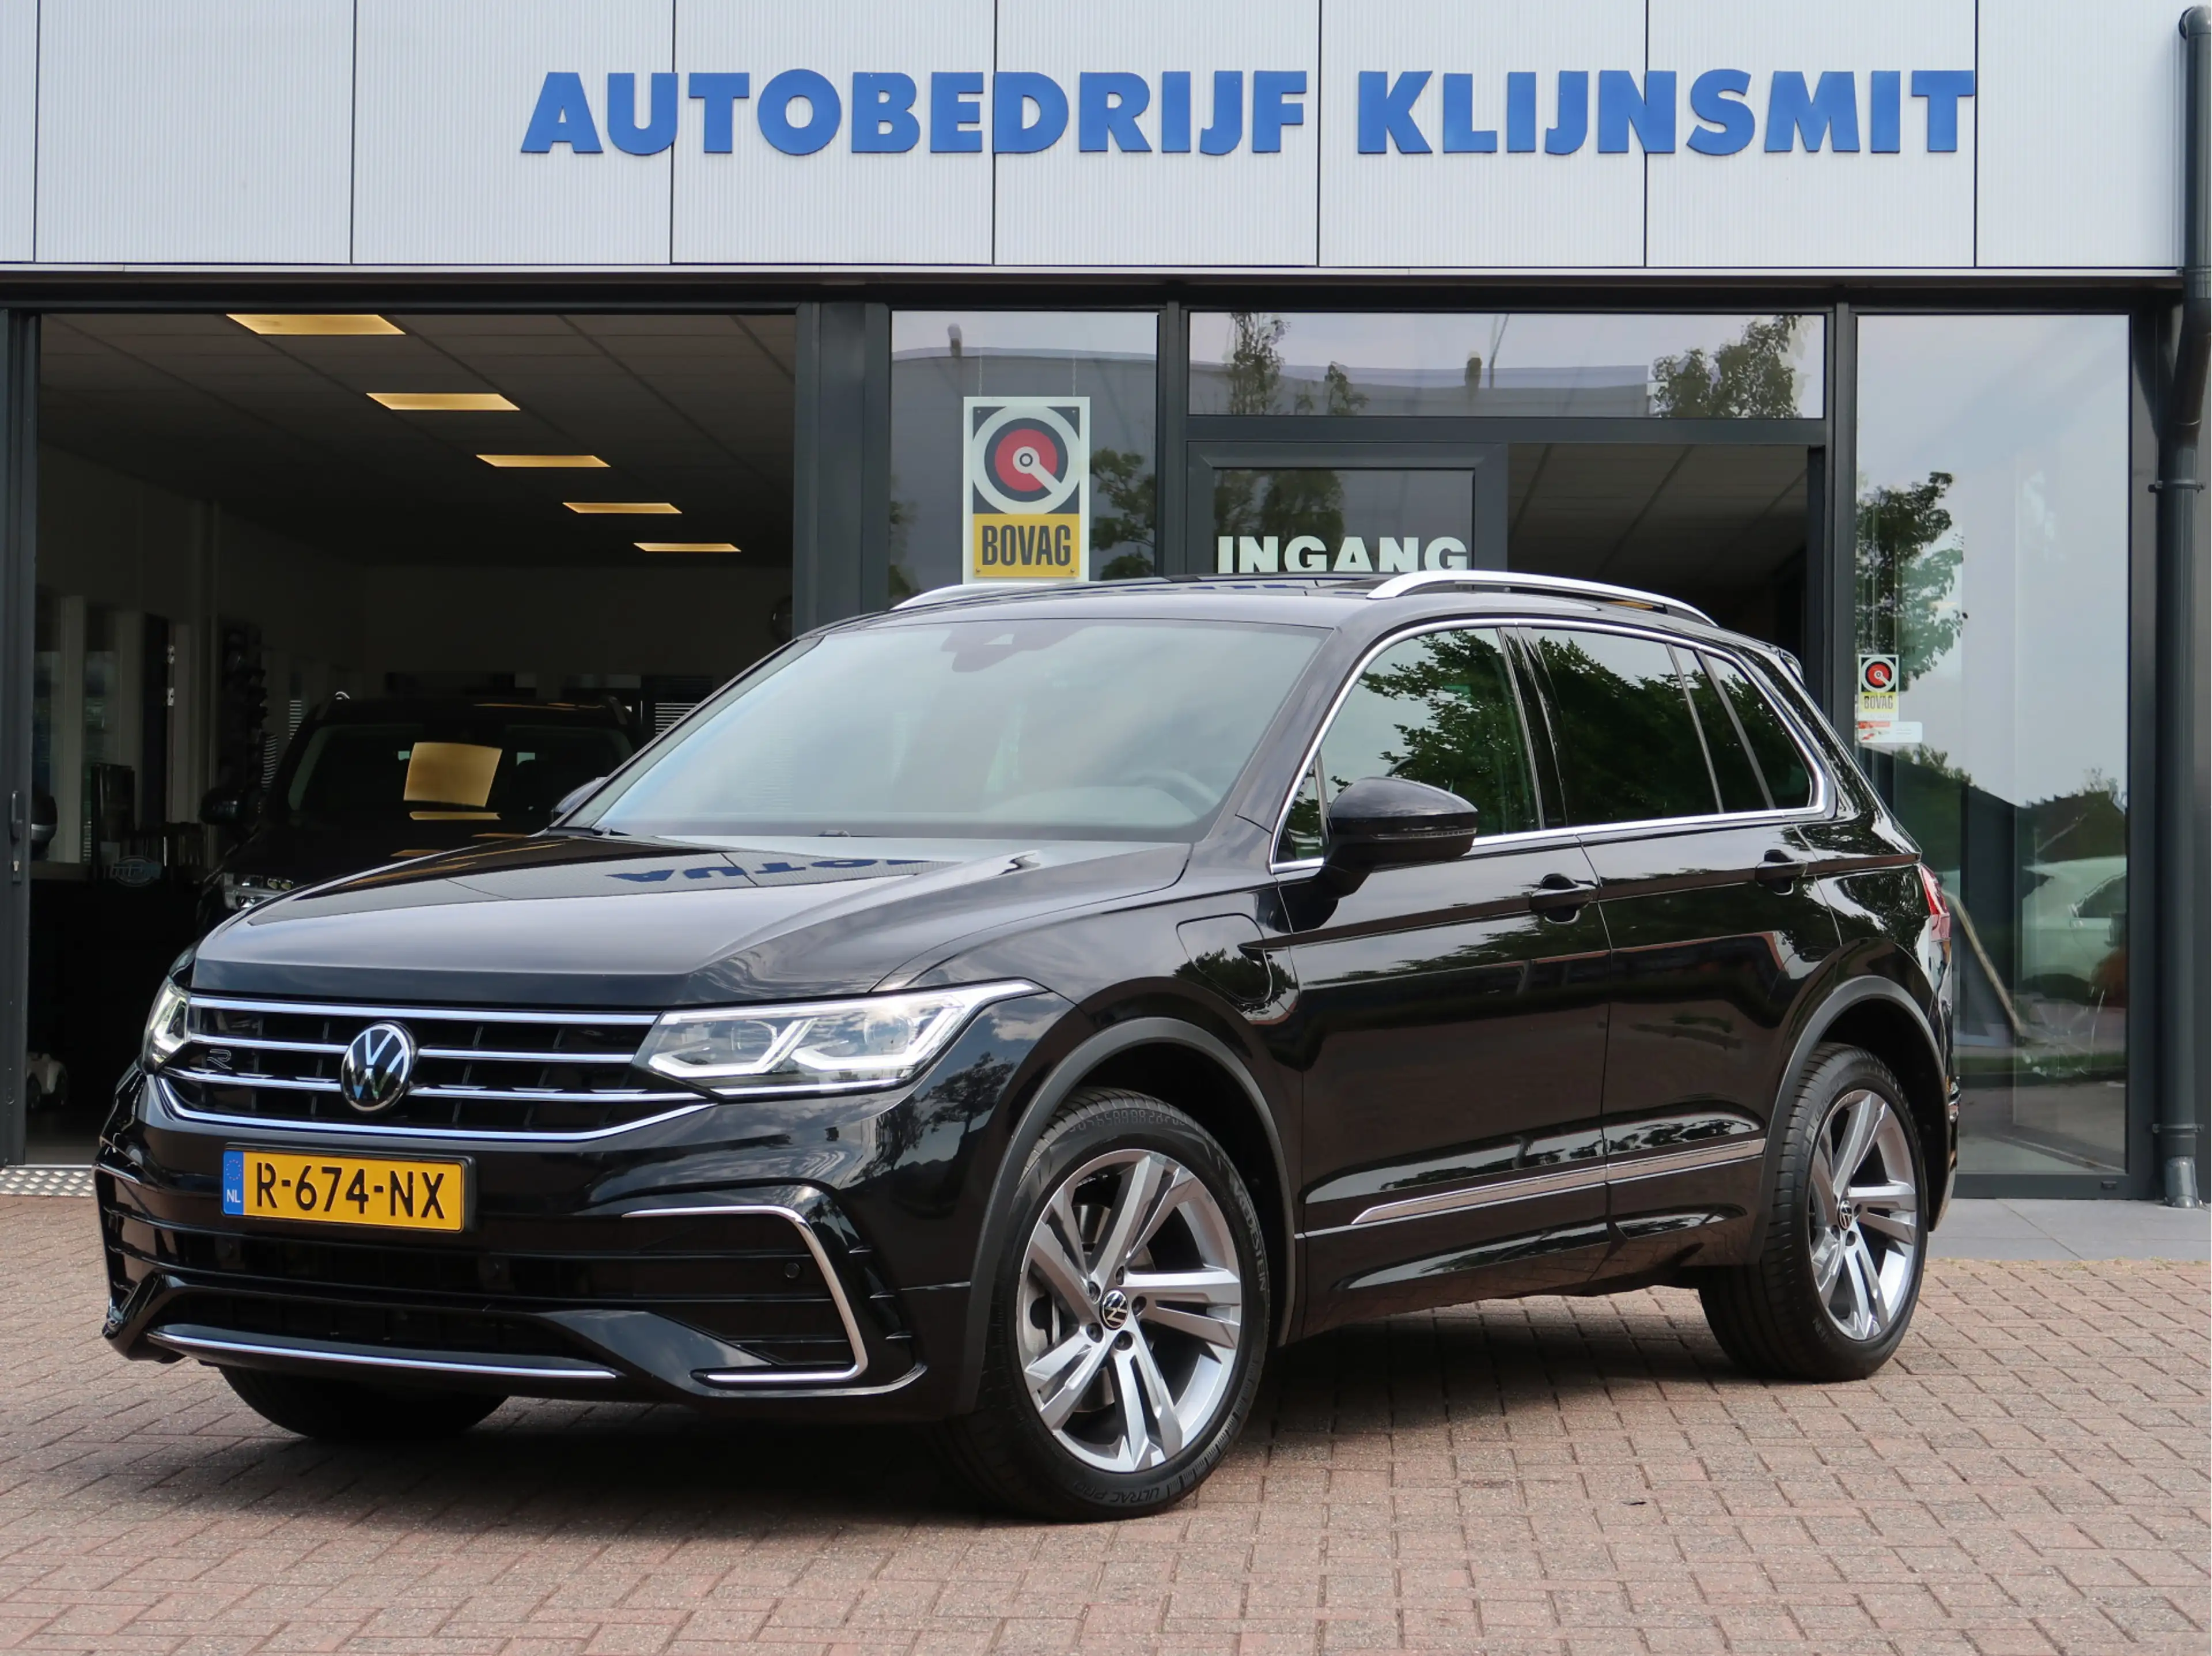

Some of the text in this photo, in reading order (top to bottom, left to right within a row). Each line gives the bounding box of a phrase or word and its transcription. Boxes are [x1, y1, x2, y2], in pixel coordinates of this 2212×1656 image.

[521, 69, 1976, 155] AUTOBEDRIJF KLIJNSMIT
[982, 524, 1071, 566] BOVAG
[1217, 536, 1468, 573] INGANG
[1863, 695, 1894, 710] BOVAG
[226, 1189, 241, 1203] NL
[255, 1161, 445, 1220] R-674-NX
